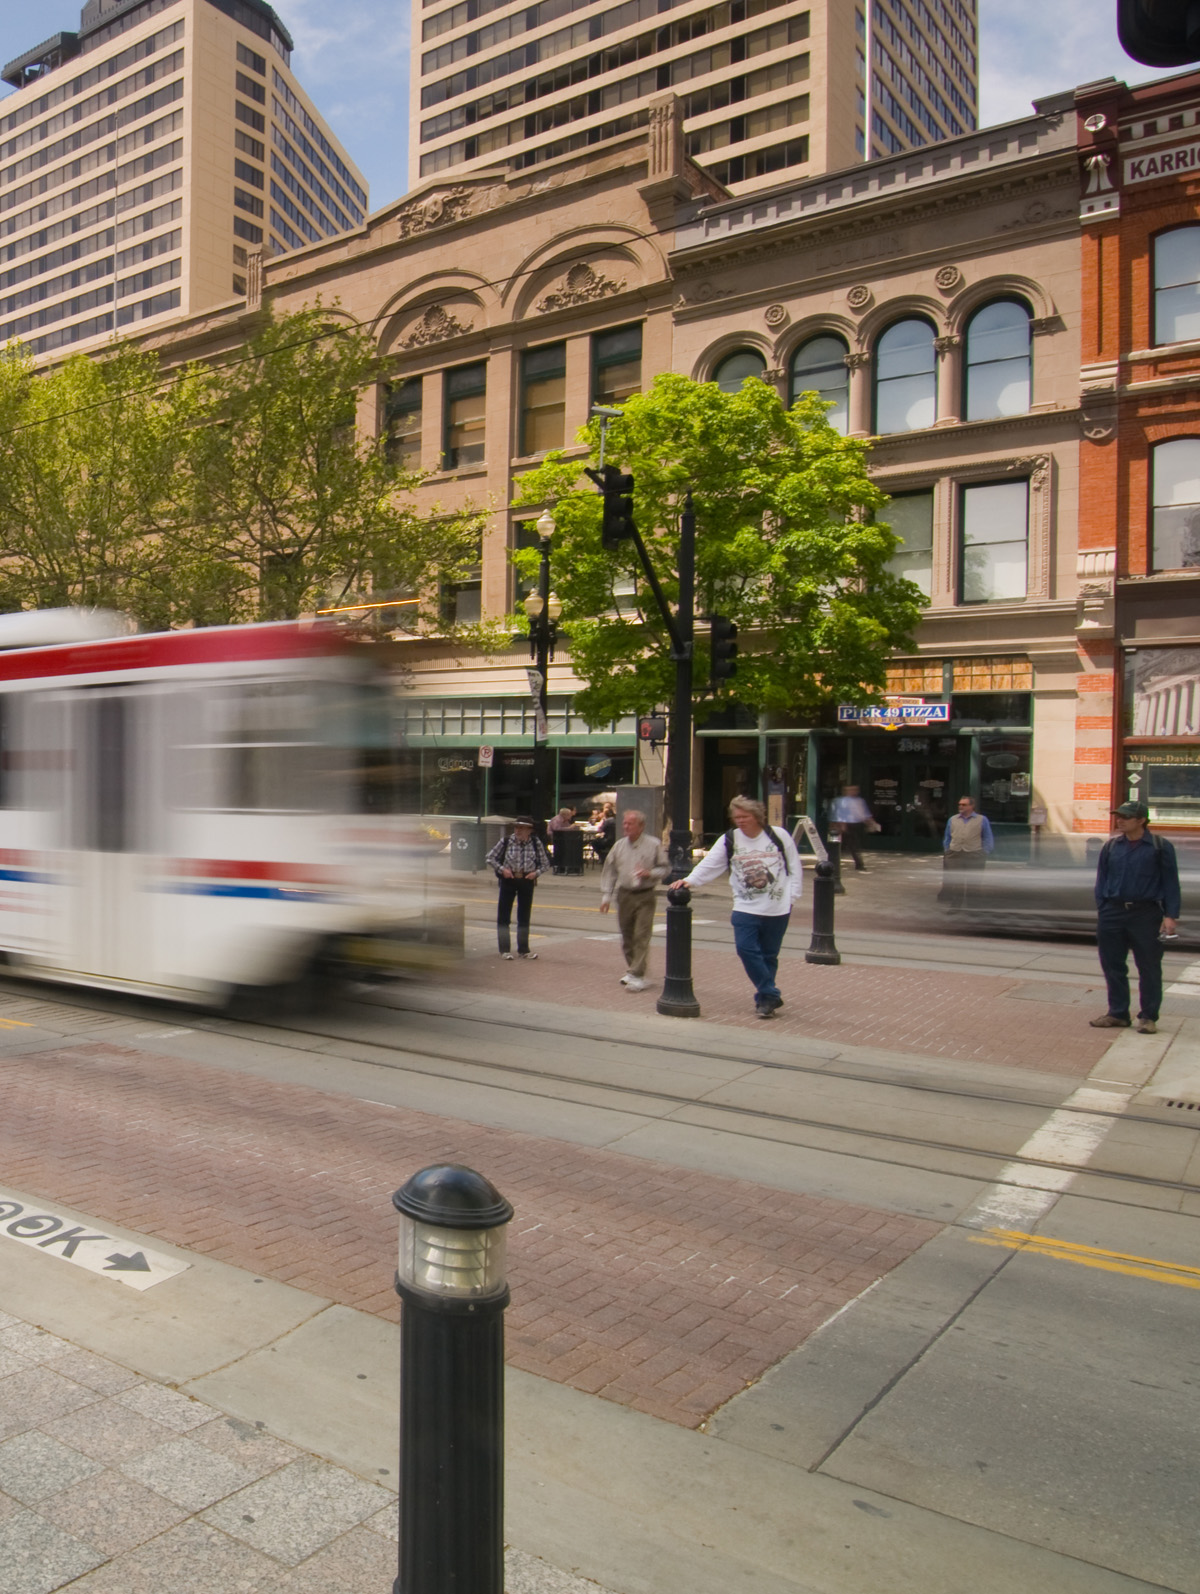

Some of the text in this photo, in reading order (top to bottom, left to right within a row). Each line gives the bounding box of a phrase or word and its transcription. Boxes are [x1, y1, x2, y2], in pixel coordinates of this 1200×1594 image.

[1130, 147, 1200, 179] KARRI
[843, 707, 943, 718] PIER 49 PIZZA
[1129, 754, 1193, 762] Wilson-Davis
